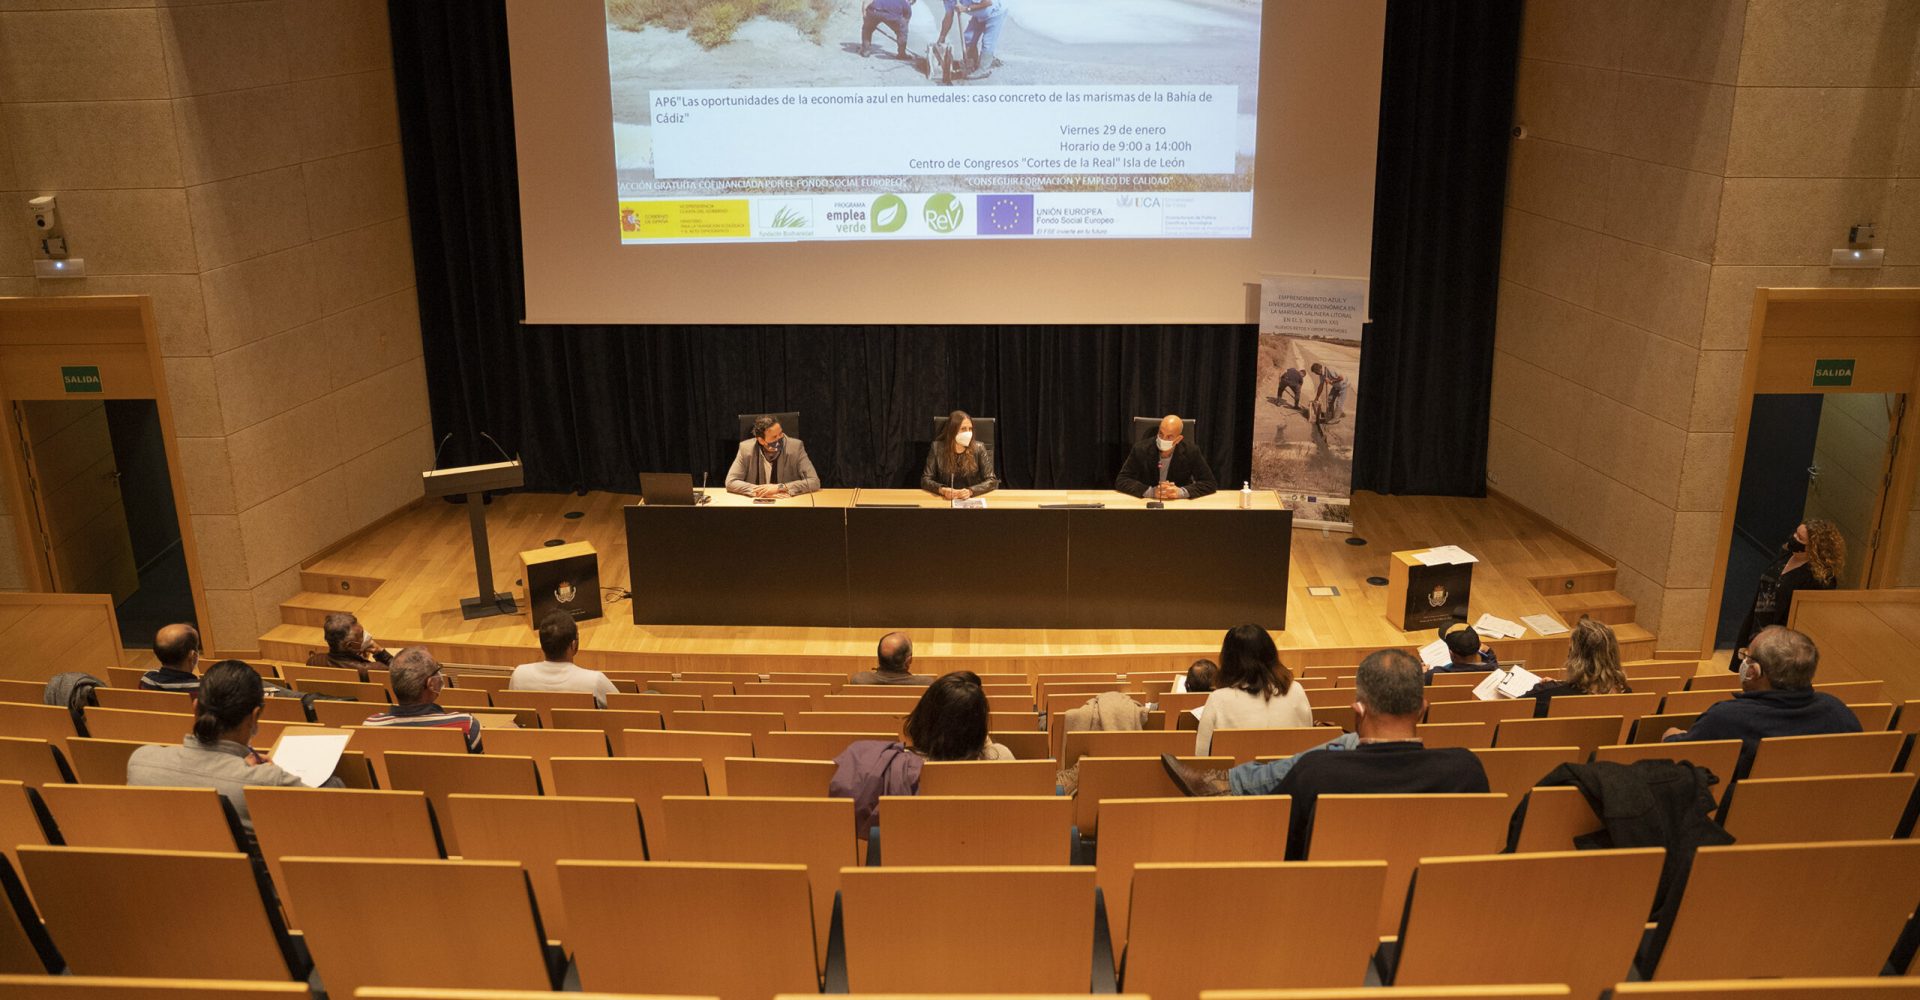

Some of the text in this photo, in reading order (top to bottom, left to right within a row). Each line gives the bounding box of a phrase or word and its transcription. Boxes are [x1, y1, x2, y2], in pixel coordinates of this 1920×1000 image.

[701, 94, 779, 110] oportunidades
[782, 94, 795, 104] de
[799, 94, 808, 104] la
[811, 93, 863, 104] economía
[866, 93, 888, 104] azul
[890, 95, 904, 104] en
[907, 92, 970, 103] humedales:
[972, 94, 996, 103] caso
[1000, 92, 1046, 103] concreto
[1049, 92, 1062, 102] de
[1066, 92, 1080, 102] las
[1083, 92, 1136, 102] marismas
[1137, 92, 1151, 102] de
[1154, 92, 1163, 102] la
[1167, 91, 1196, 102] Bahía
[1199, 91, 1212, 102] de
[656, 112, 690, 124] Cádiz"
[1060, 124, 1166, 135] Viernes 29 de enero
[1060, 141, 1192, 151] Horario de 9:00 a 14:00h
[909, 156, 1185, 170] Centro de Congresos "Cortes de la Real" Isla de León
[766, 179, 784, 188] POR
[785, 179, 795, 188] EL
[797, 178, 828, 187] FONDO
[829, 178, 858, 187] SOCIAL
[1020, 175, 1073, 186] FORMACIÓN
[1074, 176, 1081, 185] Y
[1082, 176, 1118, 185] EMPLEO
[1119, 176, 1130, 185] DE
[826, 209, 865, 223] emplea
[1036, 207, 1103, 216] UNIÓN EUROPEA
[1061, 216, 1082, 224] Social
[1084, 217, 1114, 225] Europeo
[836, 222, 866, 233] verde
[1815, 368, 1852, 377] SALIDA
[64, 375, 100, 384] SALIDA
